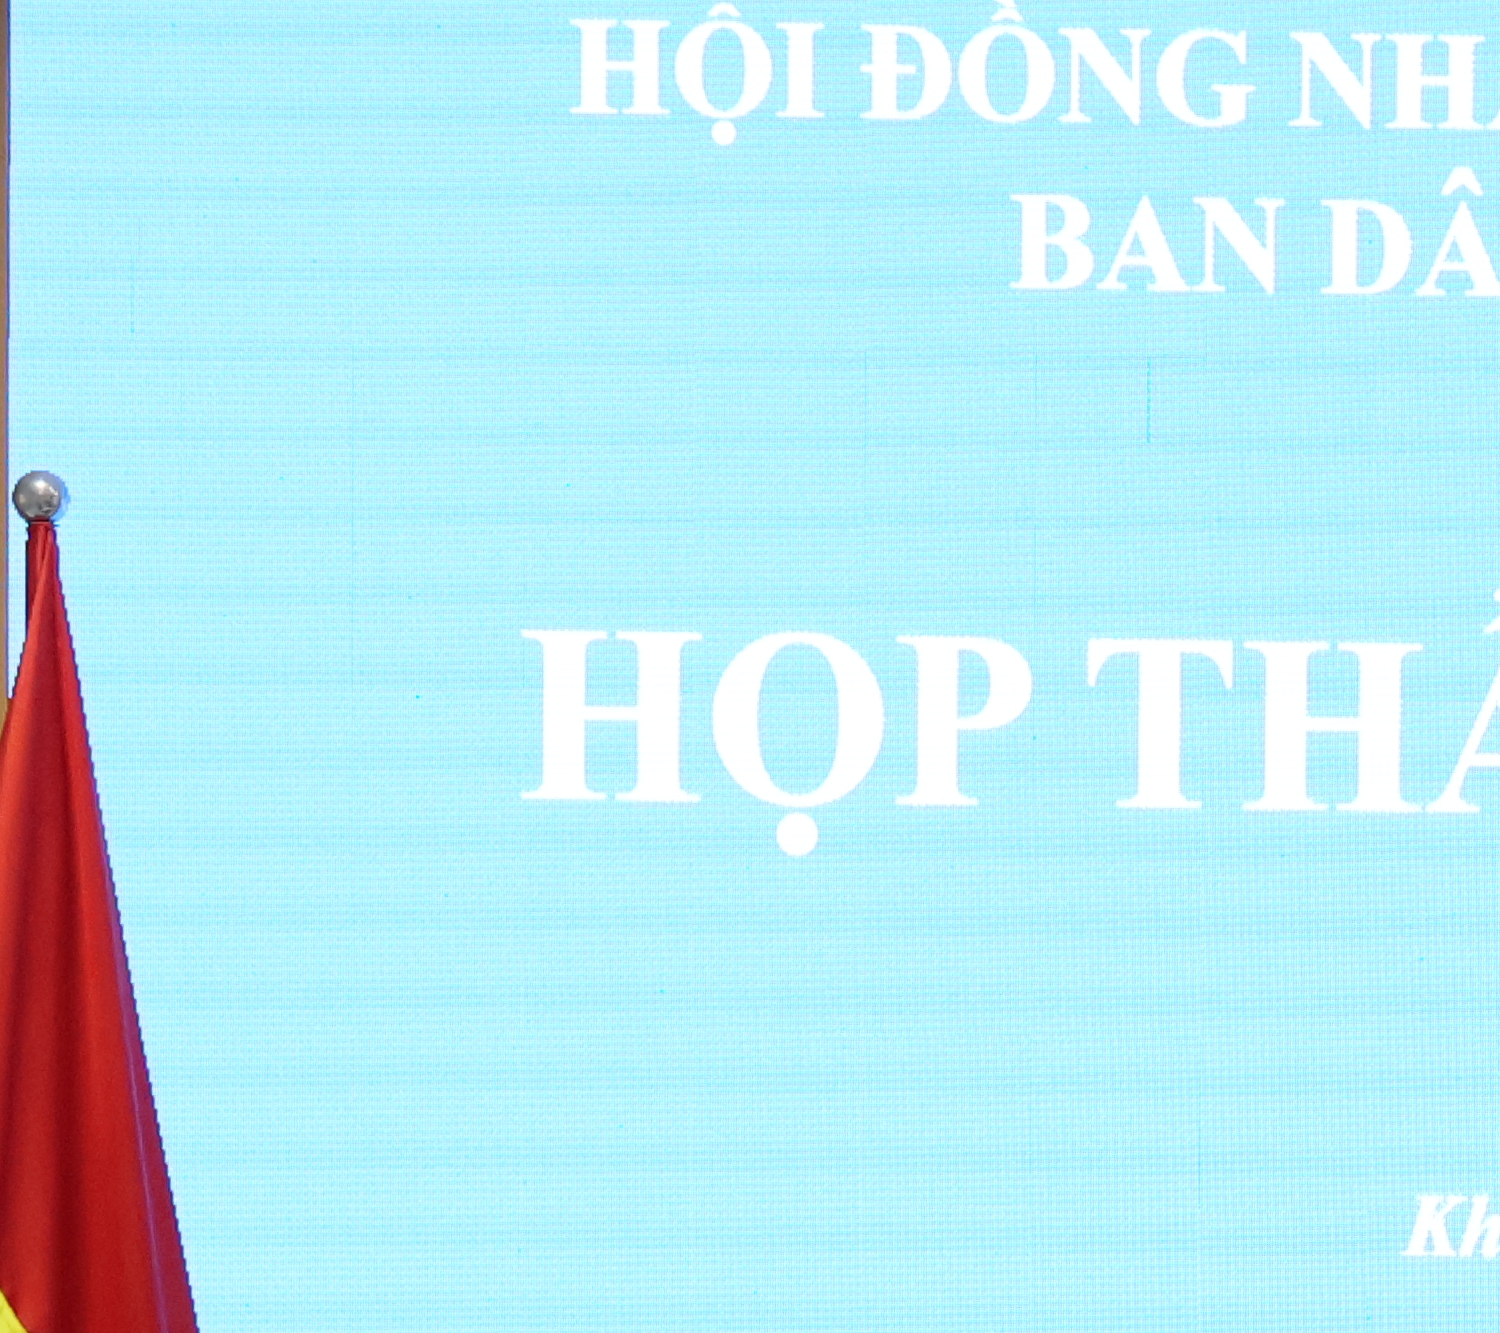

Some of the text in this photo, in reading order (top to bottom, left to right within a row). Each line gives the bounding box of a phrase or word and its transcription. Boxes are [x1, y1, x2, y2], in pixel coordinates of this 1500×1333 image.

[569, 1, 825, 146] HỘI
[859, 0, 1256, 128] ĐỒNG
[1011, 193, 1285, 296] BAN
[520, 628, 1034, 858] HỌP
